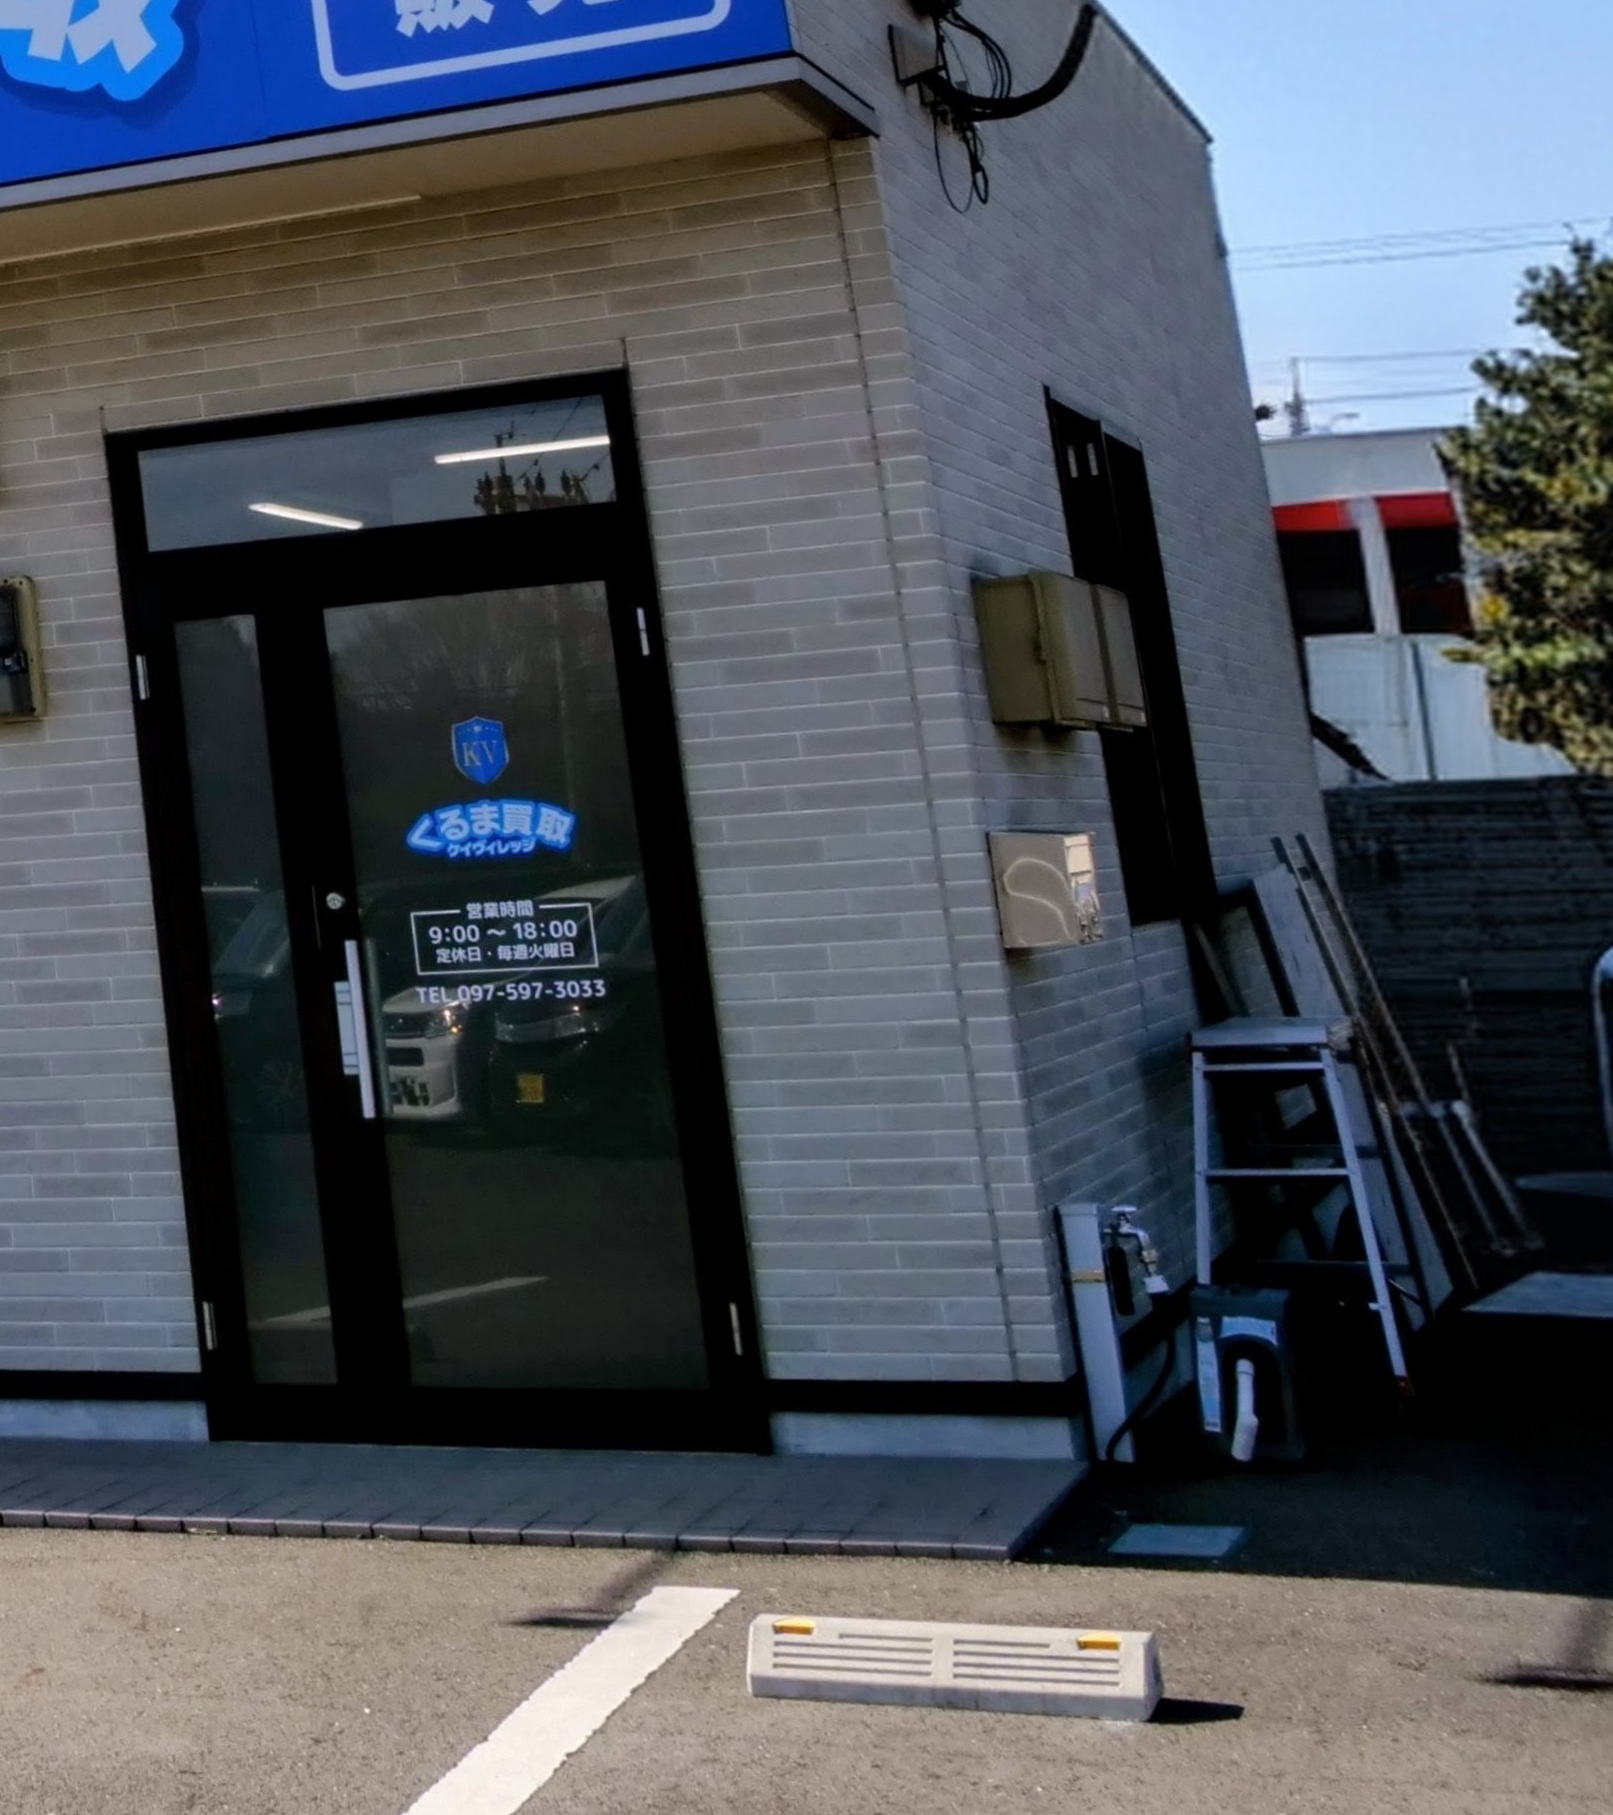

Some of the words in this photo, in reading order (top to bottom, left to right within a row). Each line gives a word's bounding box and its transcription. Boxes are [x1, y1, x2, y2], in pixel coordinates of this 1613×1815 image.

[462, 739, 497, 767] KV
[410, 802, 572, 848] くるま買取
[466, 900, 535, 920] 営業時間
[428, 924, 480, 944] 9:00
[512, 919, 578, 940] 18:00
[415, 985, 452, 1003] TEL
[456, 979, 607, 1002] 097-597-3033
